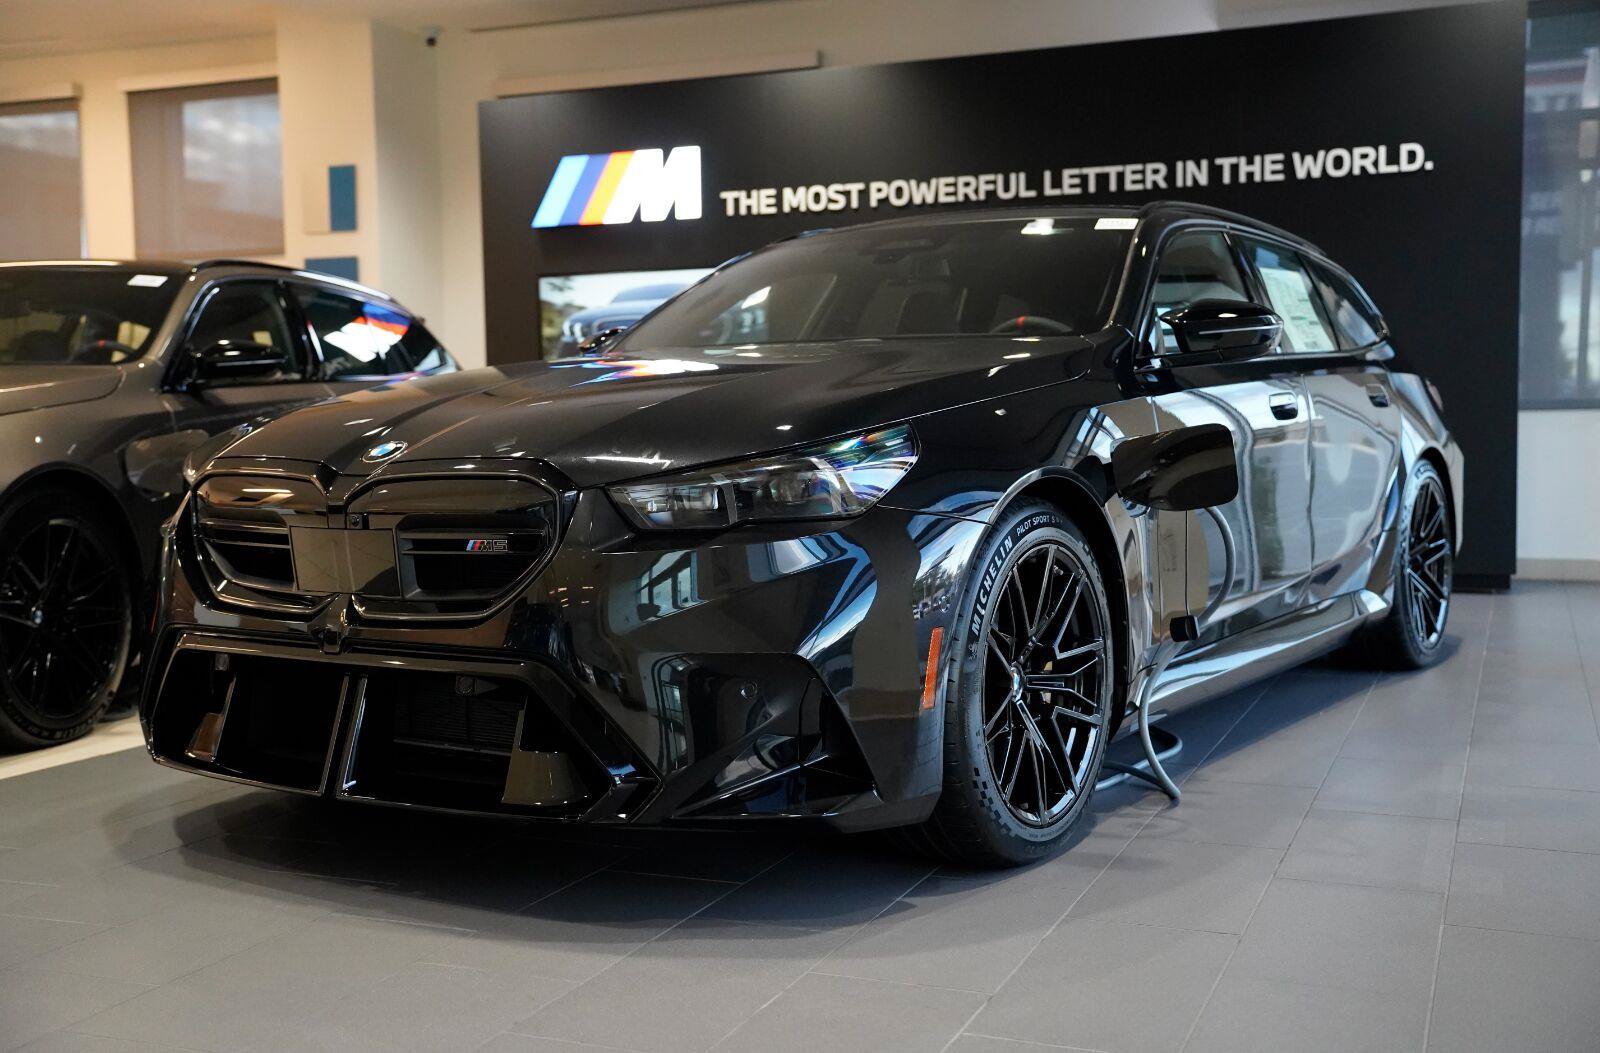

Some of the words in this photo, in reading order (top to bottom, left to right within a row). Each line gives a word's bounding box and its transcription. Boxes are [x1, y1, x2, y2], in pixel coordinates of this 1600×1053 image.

[598, 145, 702, 226] M
[719, 188, 778, 217] THE
[781, 182, 866, 214] MOST
[868, 173, 1037, 208] POWERFUL
[1043, 162, 1168, 196] LETTER
[1175, 159, 1209, 188] IN
[1214, 153, 1285, 185] THE
[1291, 142, 1435, 180] WORLD.
[475, 540, 508, 552] M5
[971, 535, 1013, 637] MICHELIN
[1016, 519, 1032, 537] PILOT
[1032, 515, 1050, 526] SPORT
